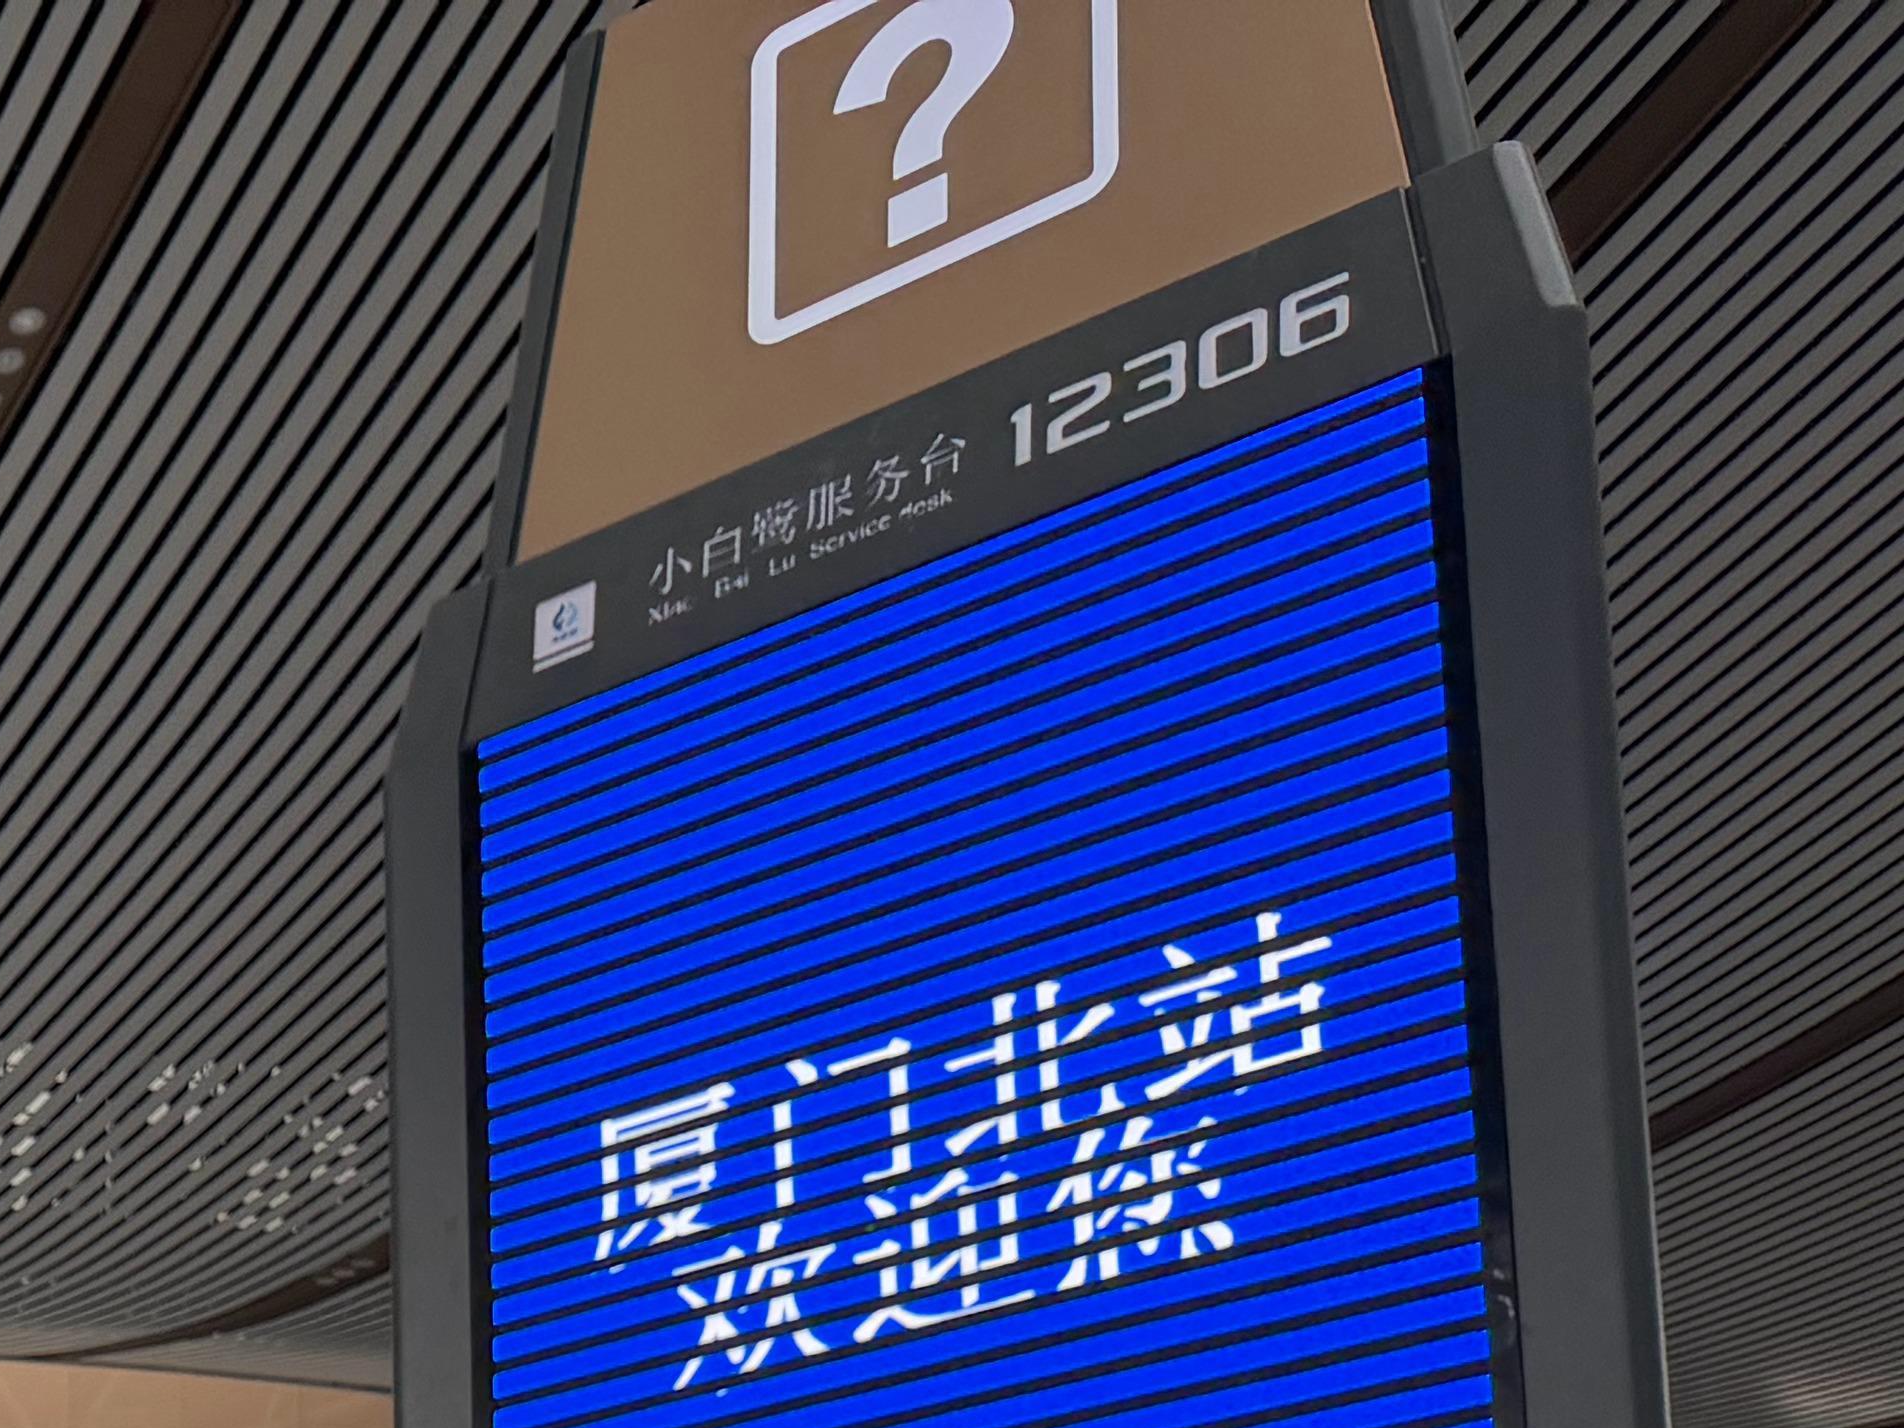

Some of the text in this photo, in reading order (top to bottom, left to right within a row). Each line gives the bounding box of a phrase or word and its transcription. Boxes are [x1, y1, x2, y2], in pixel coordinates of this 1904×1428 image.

[1011, 274, 1350, 467] 12306
[649, 433, 966, 595] 小白鹭服务台
[769, 555, 796, 577] Lu
[809, 514, 892, 560] Service
[594, 911, 1333, 1270] 厦门北站
[672, 1115, 1235, 1395] 欢迎您
